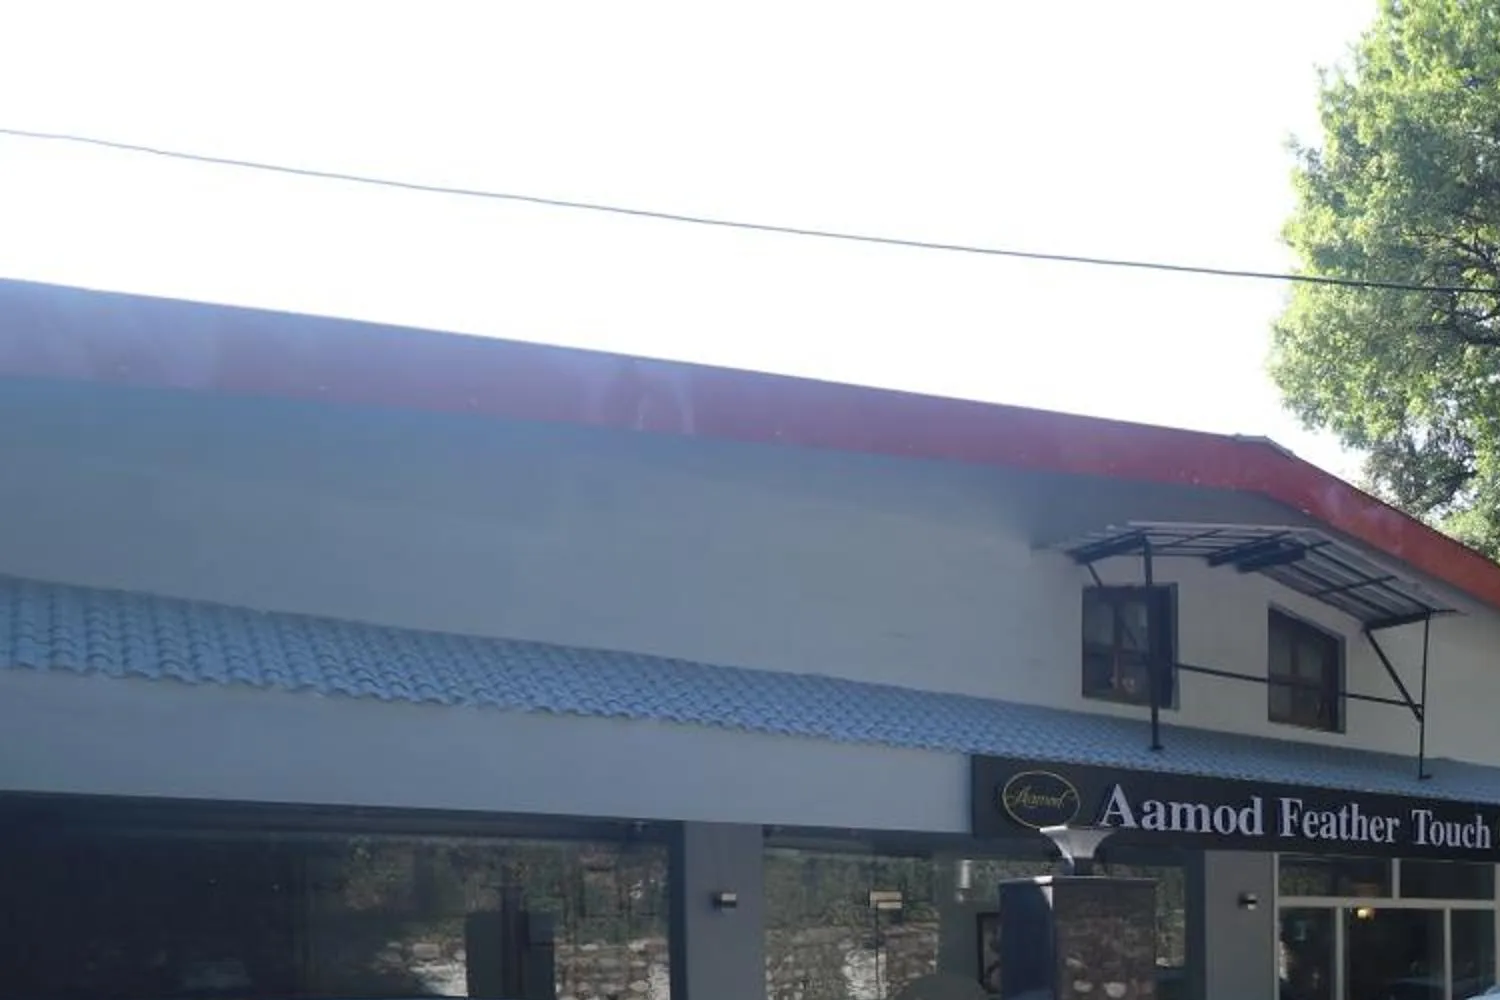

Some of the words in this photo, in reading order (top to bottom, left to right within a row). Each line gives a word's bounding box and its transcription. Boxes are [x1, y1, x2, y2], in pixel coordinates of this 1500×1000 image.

[1099, 783, 1265, 836] Aamod
[1279, 797, 1401, 843] Feather
[1411, 809, 1491, 849] Touch
